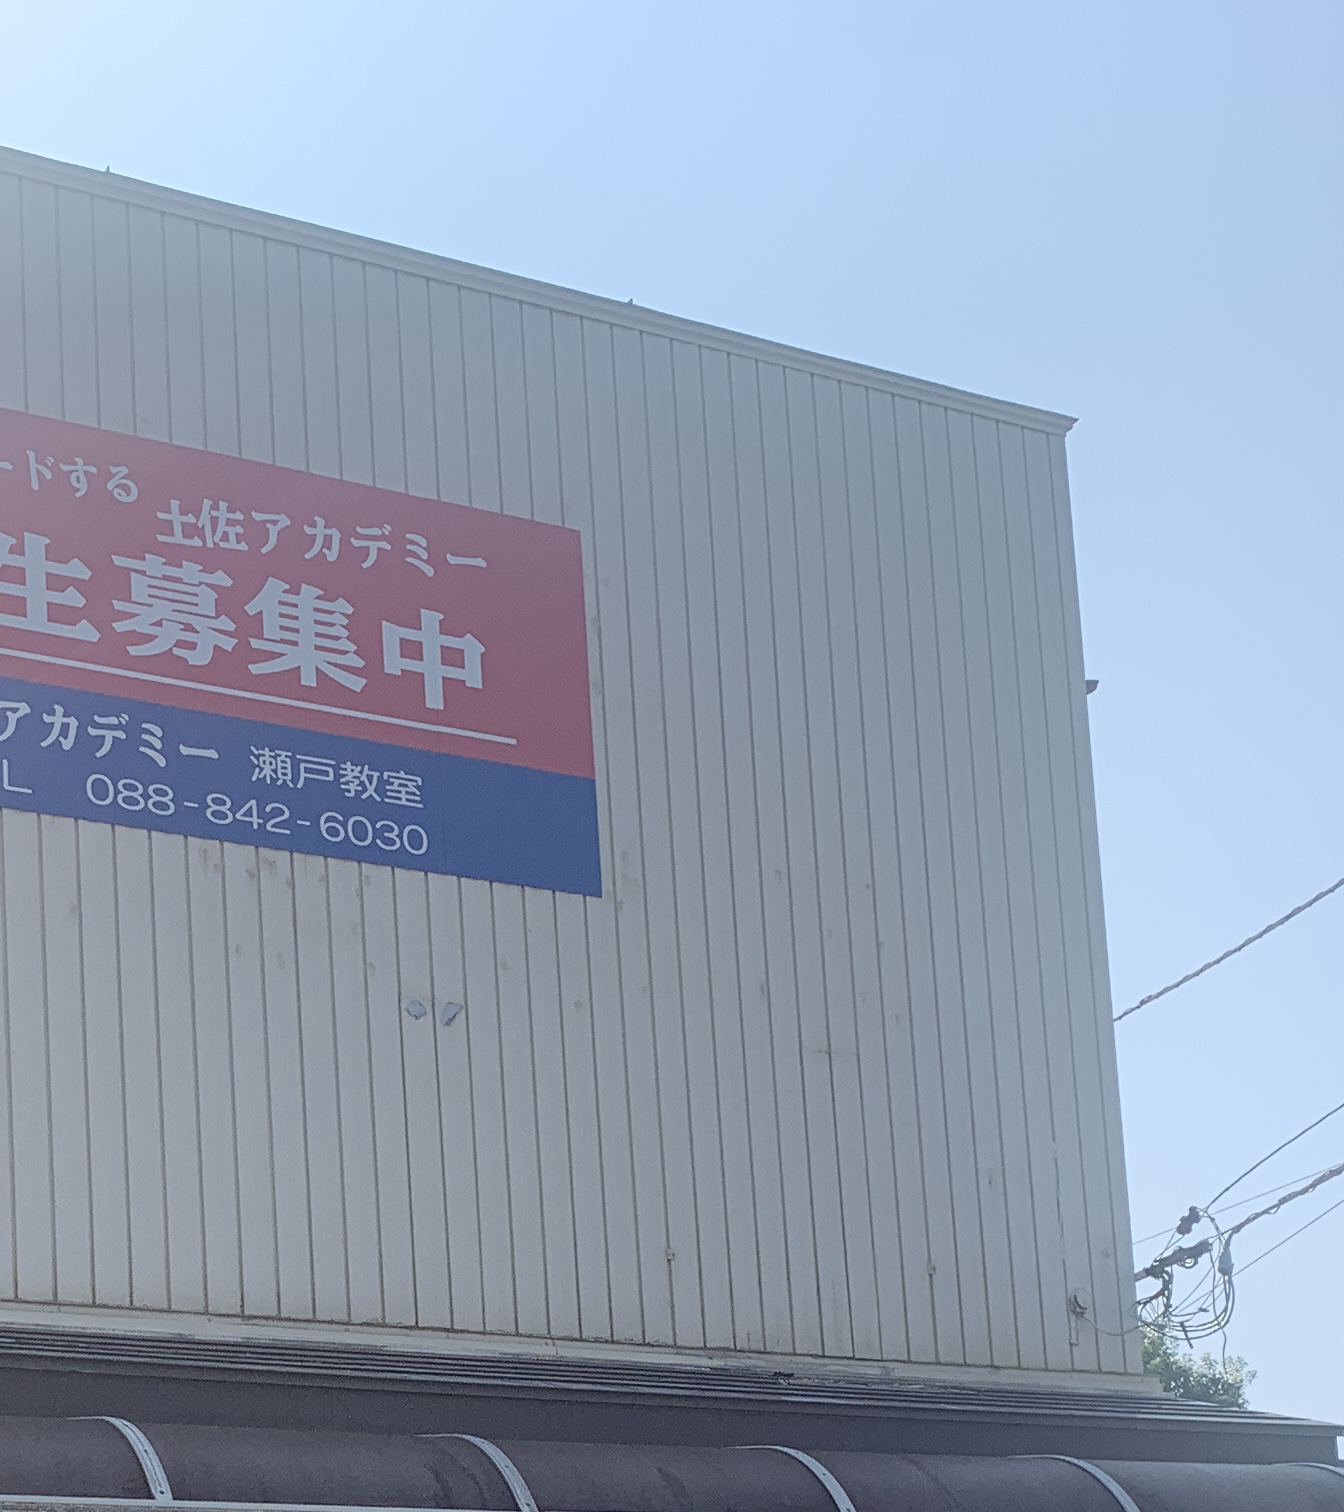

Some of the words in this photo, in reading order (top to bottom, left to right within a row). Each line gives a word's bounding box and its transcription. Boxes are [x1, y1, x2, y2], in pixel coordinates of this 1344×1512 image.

[154, 498, 489, 578] 土佐アカデミー
[84, 772, 430, 858] 088-842-6030
[248, 742, 424, 810] 瀬戸教室
